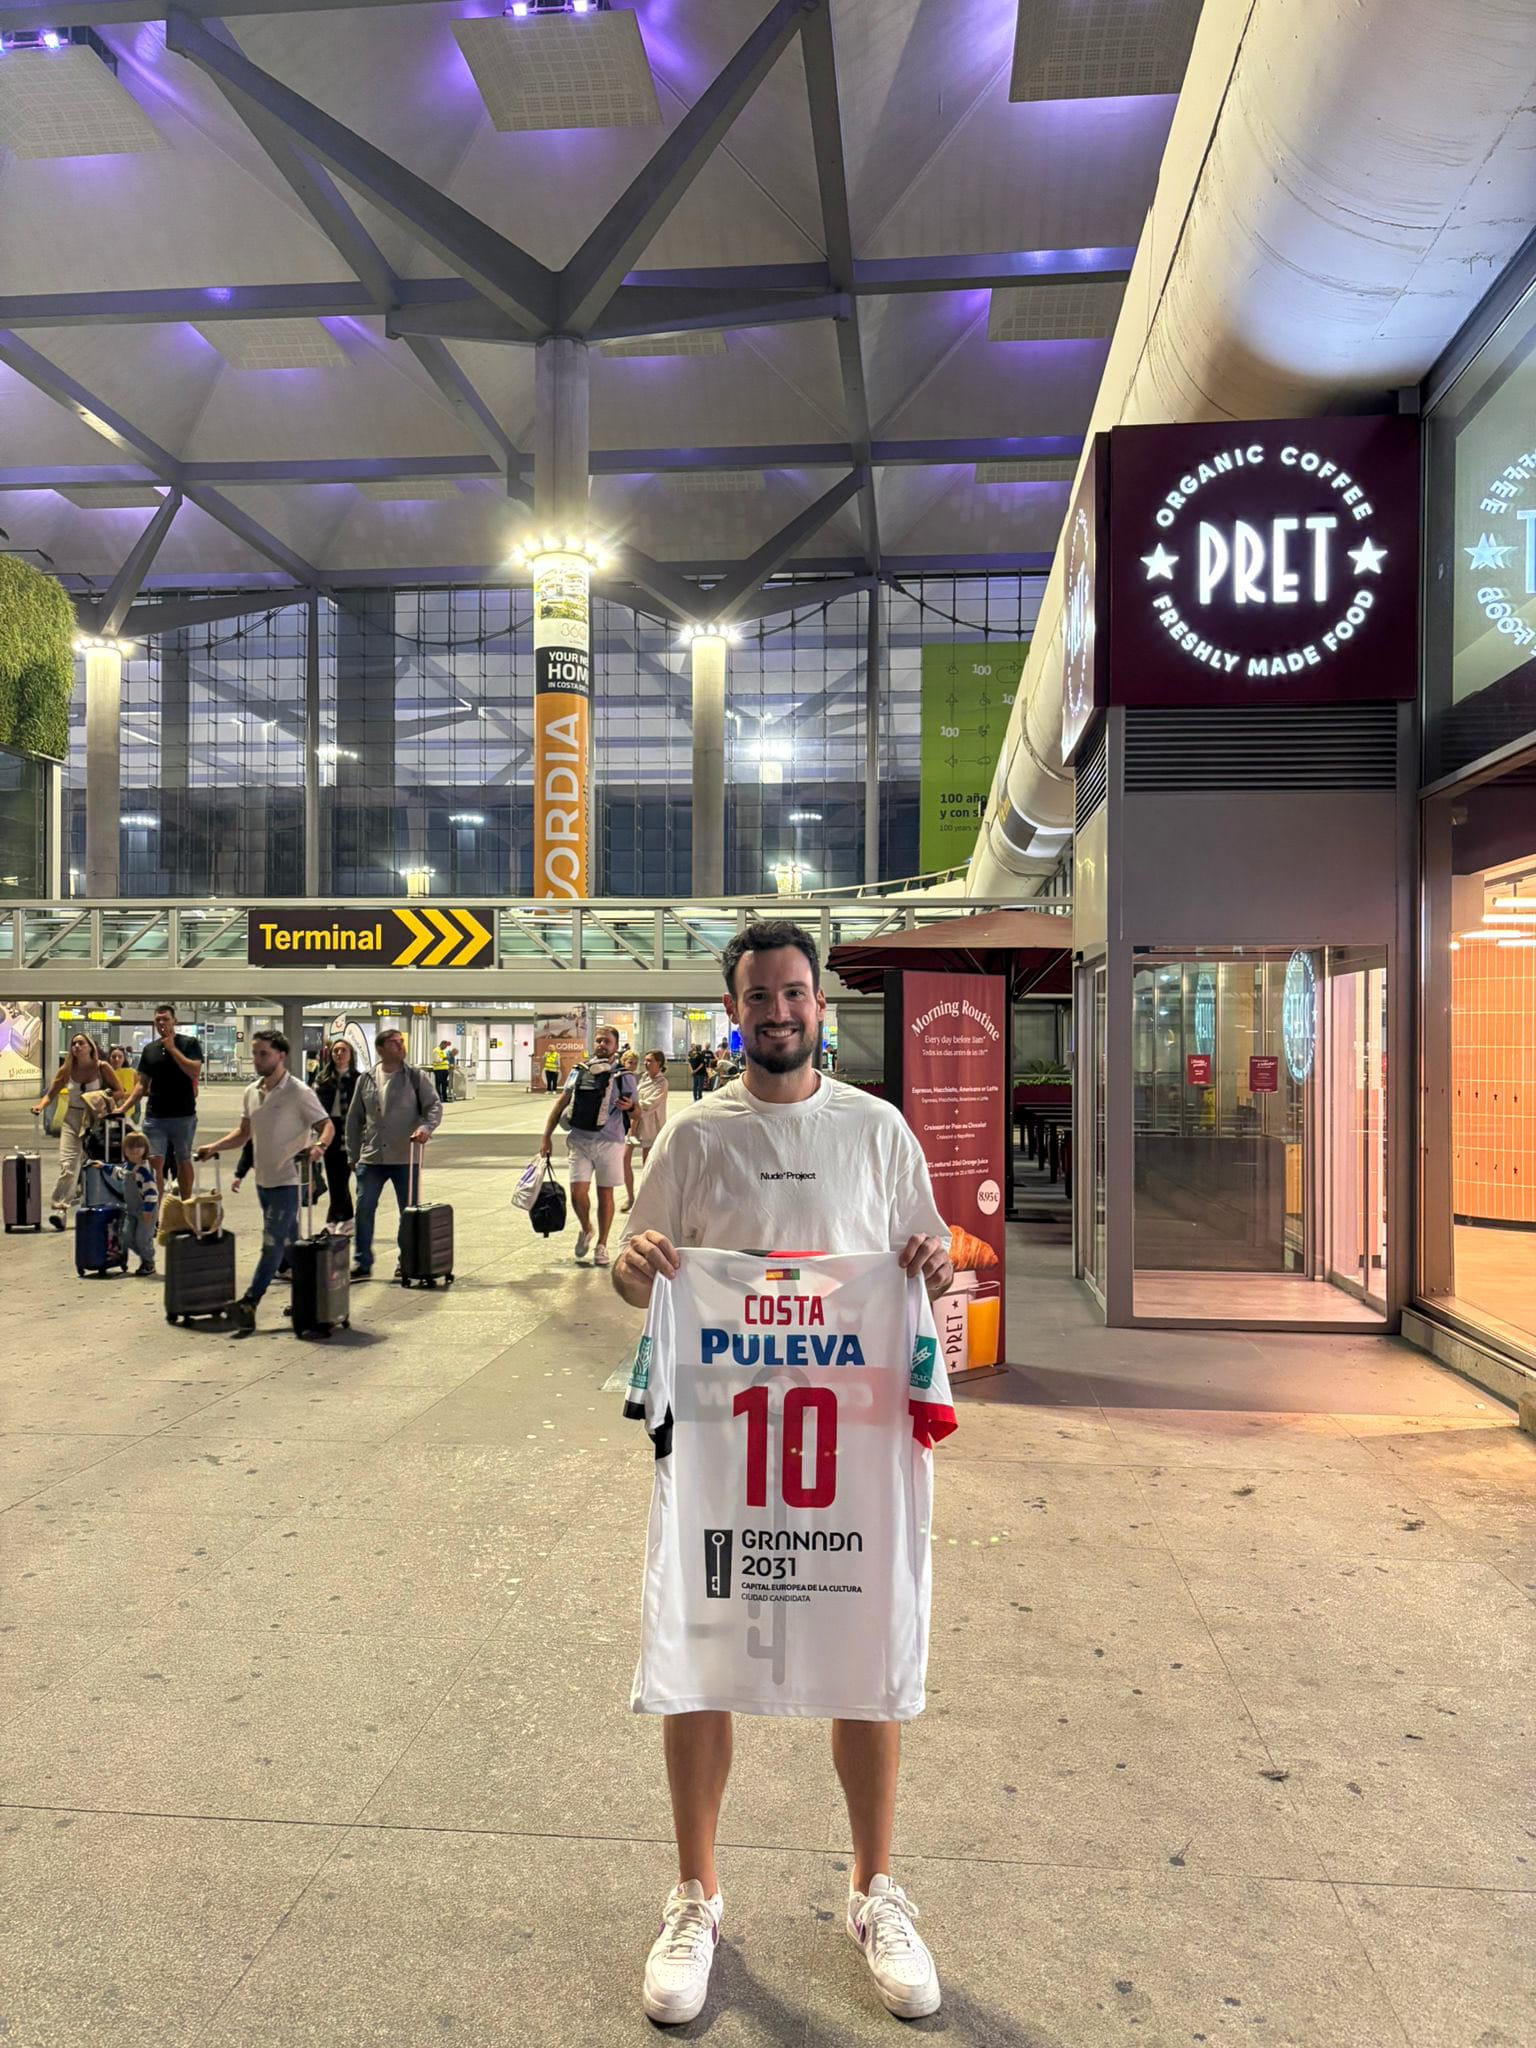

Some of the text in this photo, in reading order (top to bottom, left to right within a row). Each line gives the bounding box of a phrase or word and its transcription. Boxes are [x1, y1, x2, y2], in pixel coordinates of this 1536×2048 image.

[1156, 445, 1373, 527] ORGANIC COFFEE
[1199, 516, 1338, 605] PRET
[1153, 590, 1374, 677] FRESHLY MADE FOOD
[548, 651, 578, 663] YOUR
[548, 663, 589, 685] HOM
[972, 664, 991, 676] 100
[557, 681, 578, 691] COSTA
[1003, 693, 1015, 705] 10
[940, 726, 959, 738] 100
[940, 791, 987, 803] 100 año
[940, 809, 947, 818] y
[950, 806, 974, 818] con
[940, 824, 952, 832] 100
[259, 924, 382, 950] Terminal
[911, 1000, 1000, 1041] Morning Routine
[786, 1172, 816, 1181] Project
[745, 1295, 824, 1327] COSTA
[946, 1315, 963, 1355] PRET
[701, 1328, 865, 1366] PULEVA
[733, 1385, 838, 1508] 10
[742, 1529, 862, 1552] GRANADA
[742, 1556, 796, 1580] 2031
[741, 1582, 770, 1591] CAPITAL
[772, 1583, 806, 1592] EUROPEA
[829, 1585, 862, 1593] CULTURA
[741, 1593, 811, 1602] CIUDAD CANDIDATA
